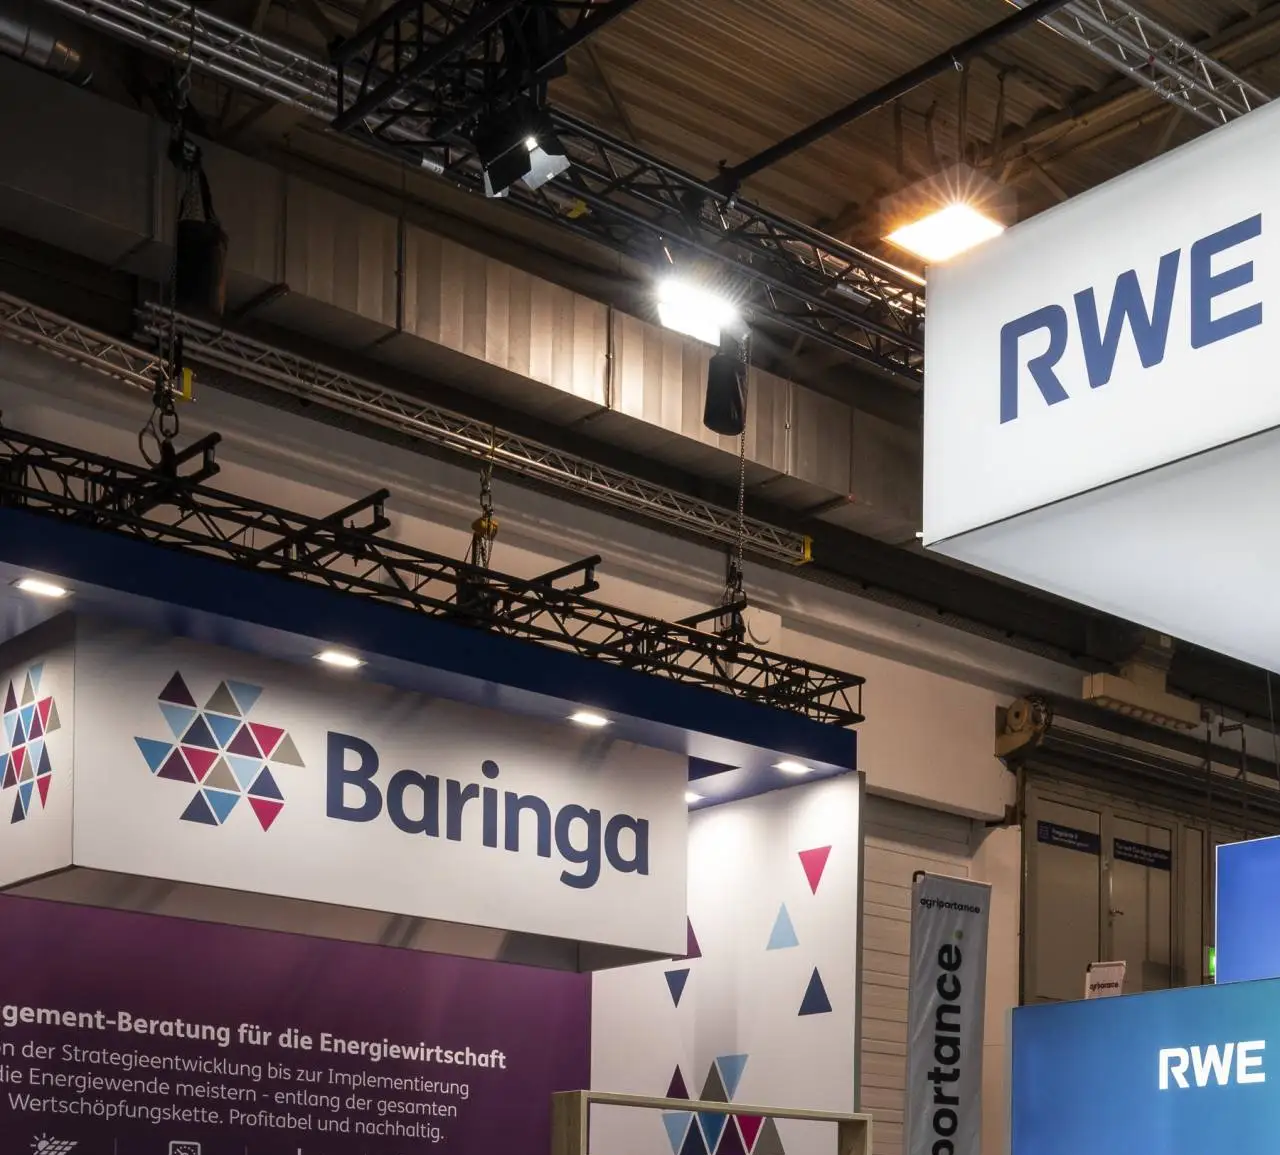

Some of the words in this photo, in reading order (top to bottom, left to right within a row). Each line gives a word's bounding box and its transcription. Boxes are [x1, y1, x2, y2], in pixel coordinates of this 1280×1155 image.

[999, 212, 1263, 426] RWE
[325, 731, 649, 890] Baringa
[21, 1040, 56, 1060] der
[61, 1044, 262, 1082] Strategieentwicklung
[267, 1062, 292, 1081] bis
[296, 1068, 323, 1084] zur
[328, 1068, 470, 1100] Implementierung
[237, 1022, 272, 1046] für
[278, 1028, 313, 1051] die
[319, 1033, 507, 1070] Energiewirtschaft
[1158, 1039, 1266, 1090] RWE
[8, 1092, 224, 1124] Wertschöpfungskette.
[229, 1109, 313, 1131] Profitabel
[318, 1116, 350, 1133] und
[355, 1119, 445, 1143] nachhaltig.
[29, 1067, 170, 1095] Energiewende
[175, 1081, 257, 1102] meistern
[274, 1089, 341, 1113] entlang
[345, 1094, 373, 1111] der
[377, 1098, 458, 1118] gesamten
